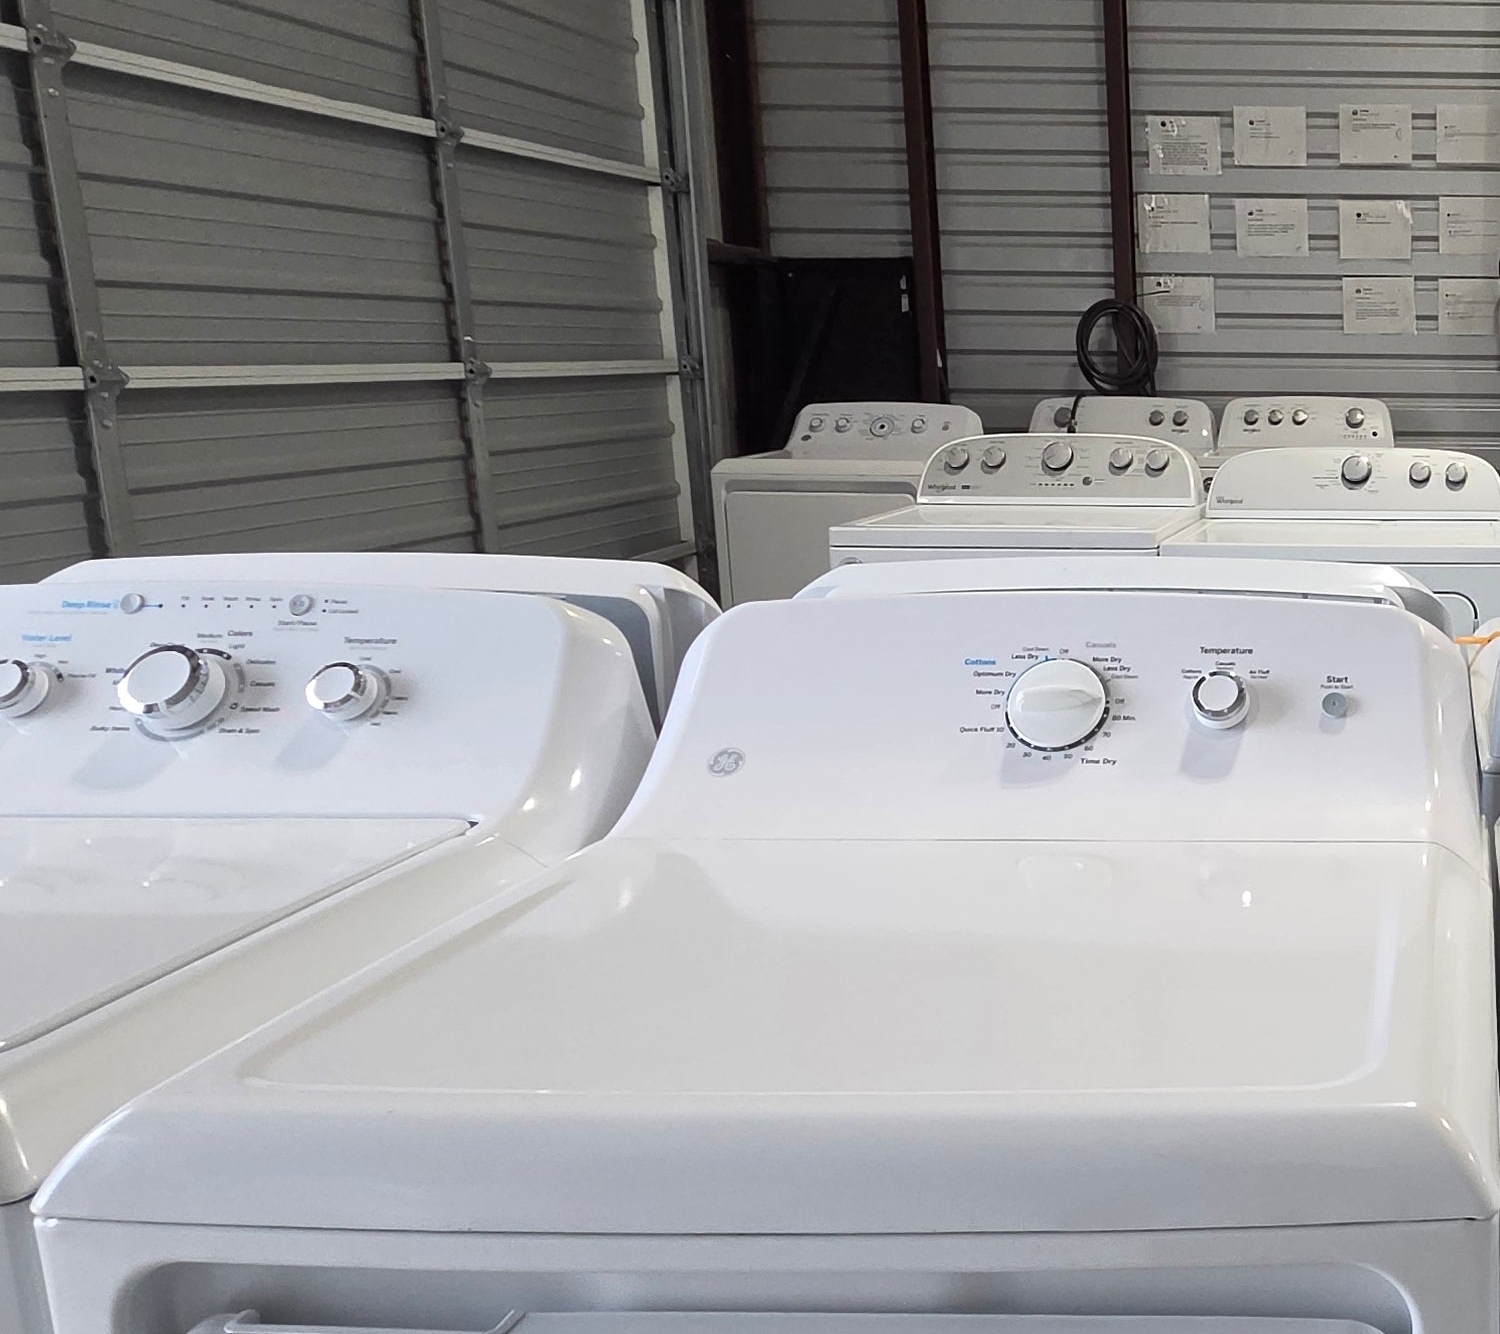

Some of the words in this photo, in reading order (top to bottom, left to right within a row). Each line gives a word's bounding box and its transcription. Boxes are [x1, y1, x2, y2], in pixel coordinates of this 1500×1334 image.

[1200, 646, 1253, 655] Temperature
[964, 658, 996, 666] Cottons
[1110, 656, 1122, 664] Dry
[1120, 665, 1131, 673] Dry
[973, 670, 1004, 678] Optimum
[1005, 671, 1017, 679] Dry
[1326, 675, 1349, 683] Start
[1102, 758, 1117, 766] Dry
